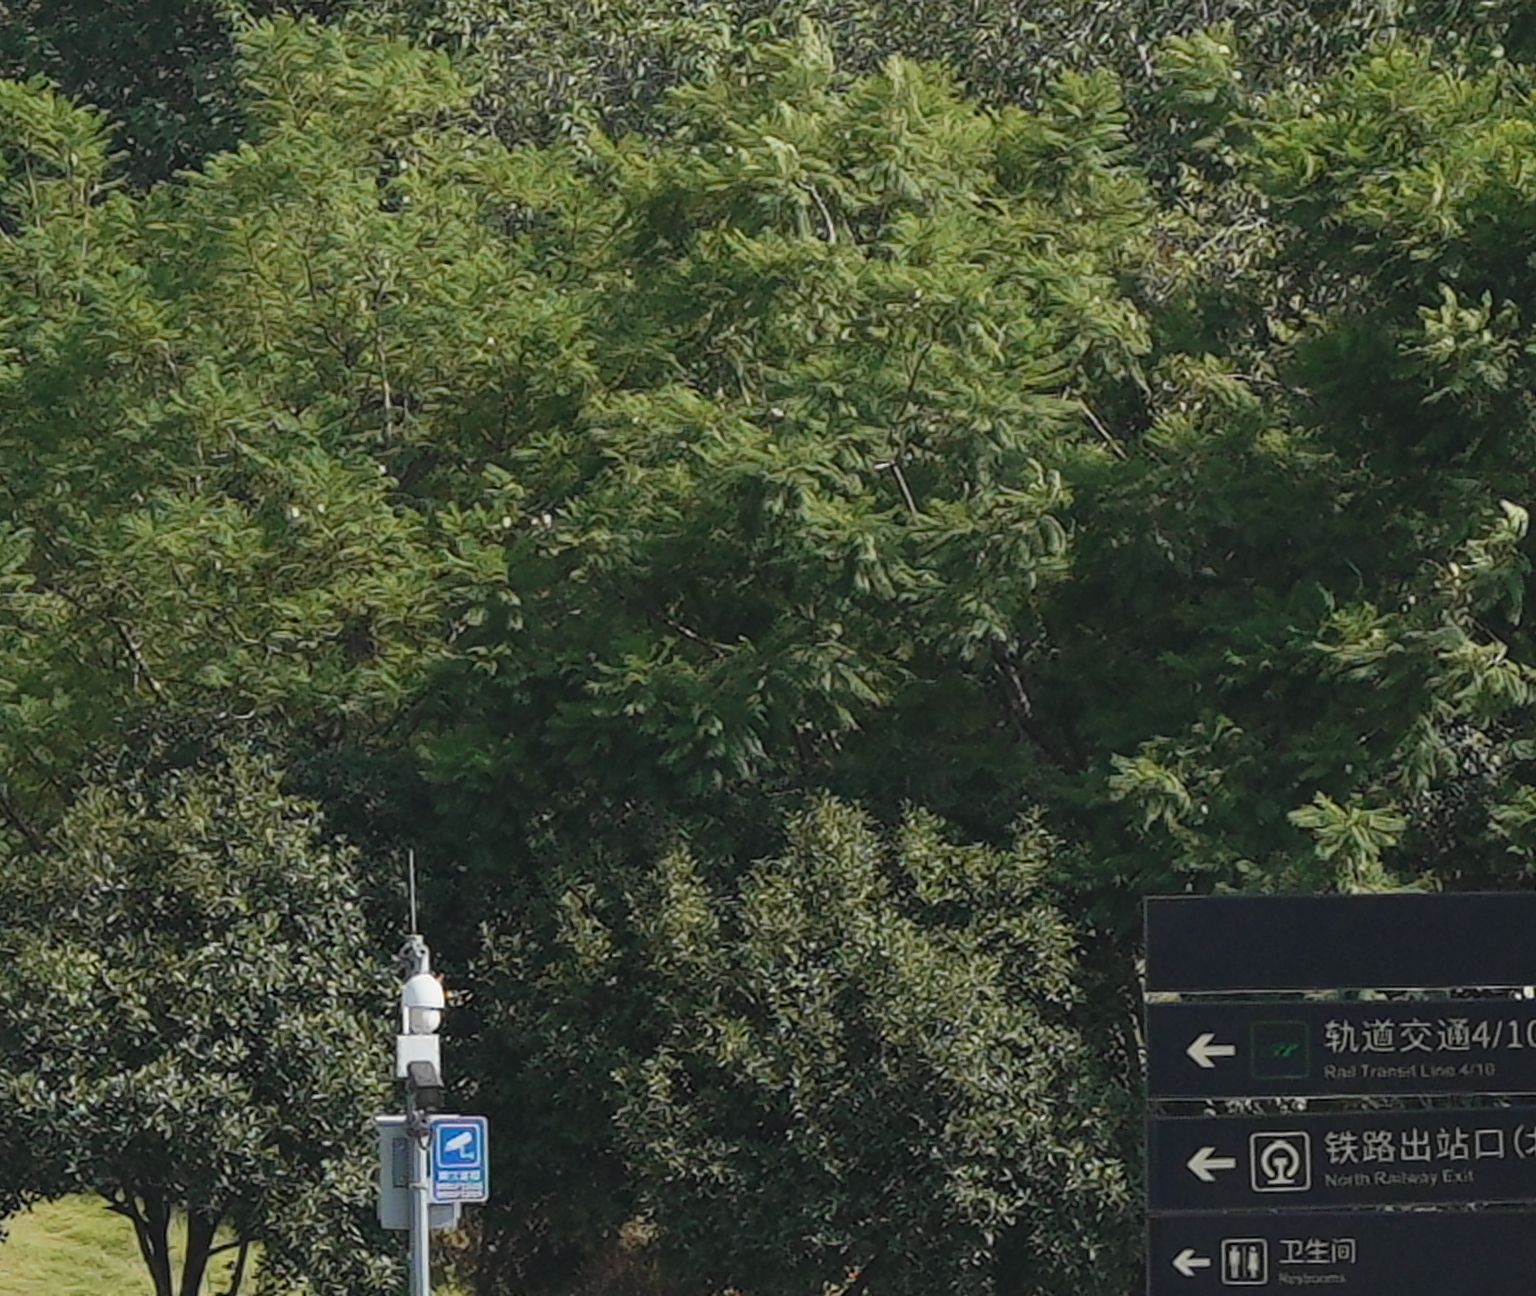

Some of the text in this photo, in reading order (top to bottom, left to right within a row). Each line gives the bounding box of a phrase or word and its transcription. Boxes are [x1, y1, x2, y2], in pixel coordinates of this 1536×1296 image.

[1361, 1063, 1417, 1079] Transit
[1420, 1063, 1456, 1079] Line
[1325, 1168, 1475, 1188] North Railway Exit
[1279, 1237, 1356, 1264] 卫生间
